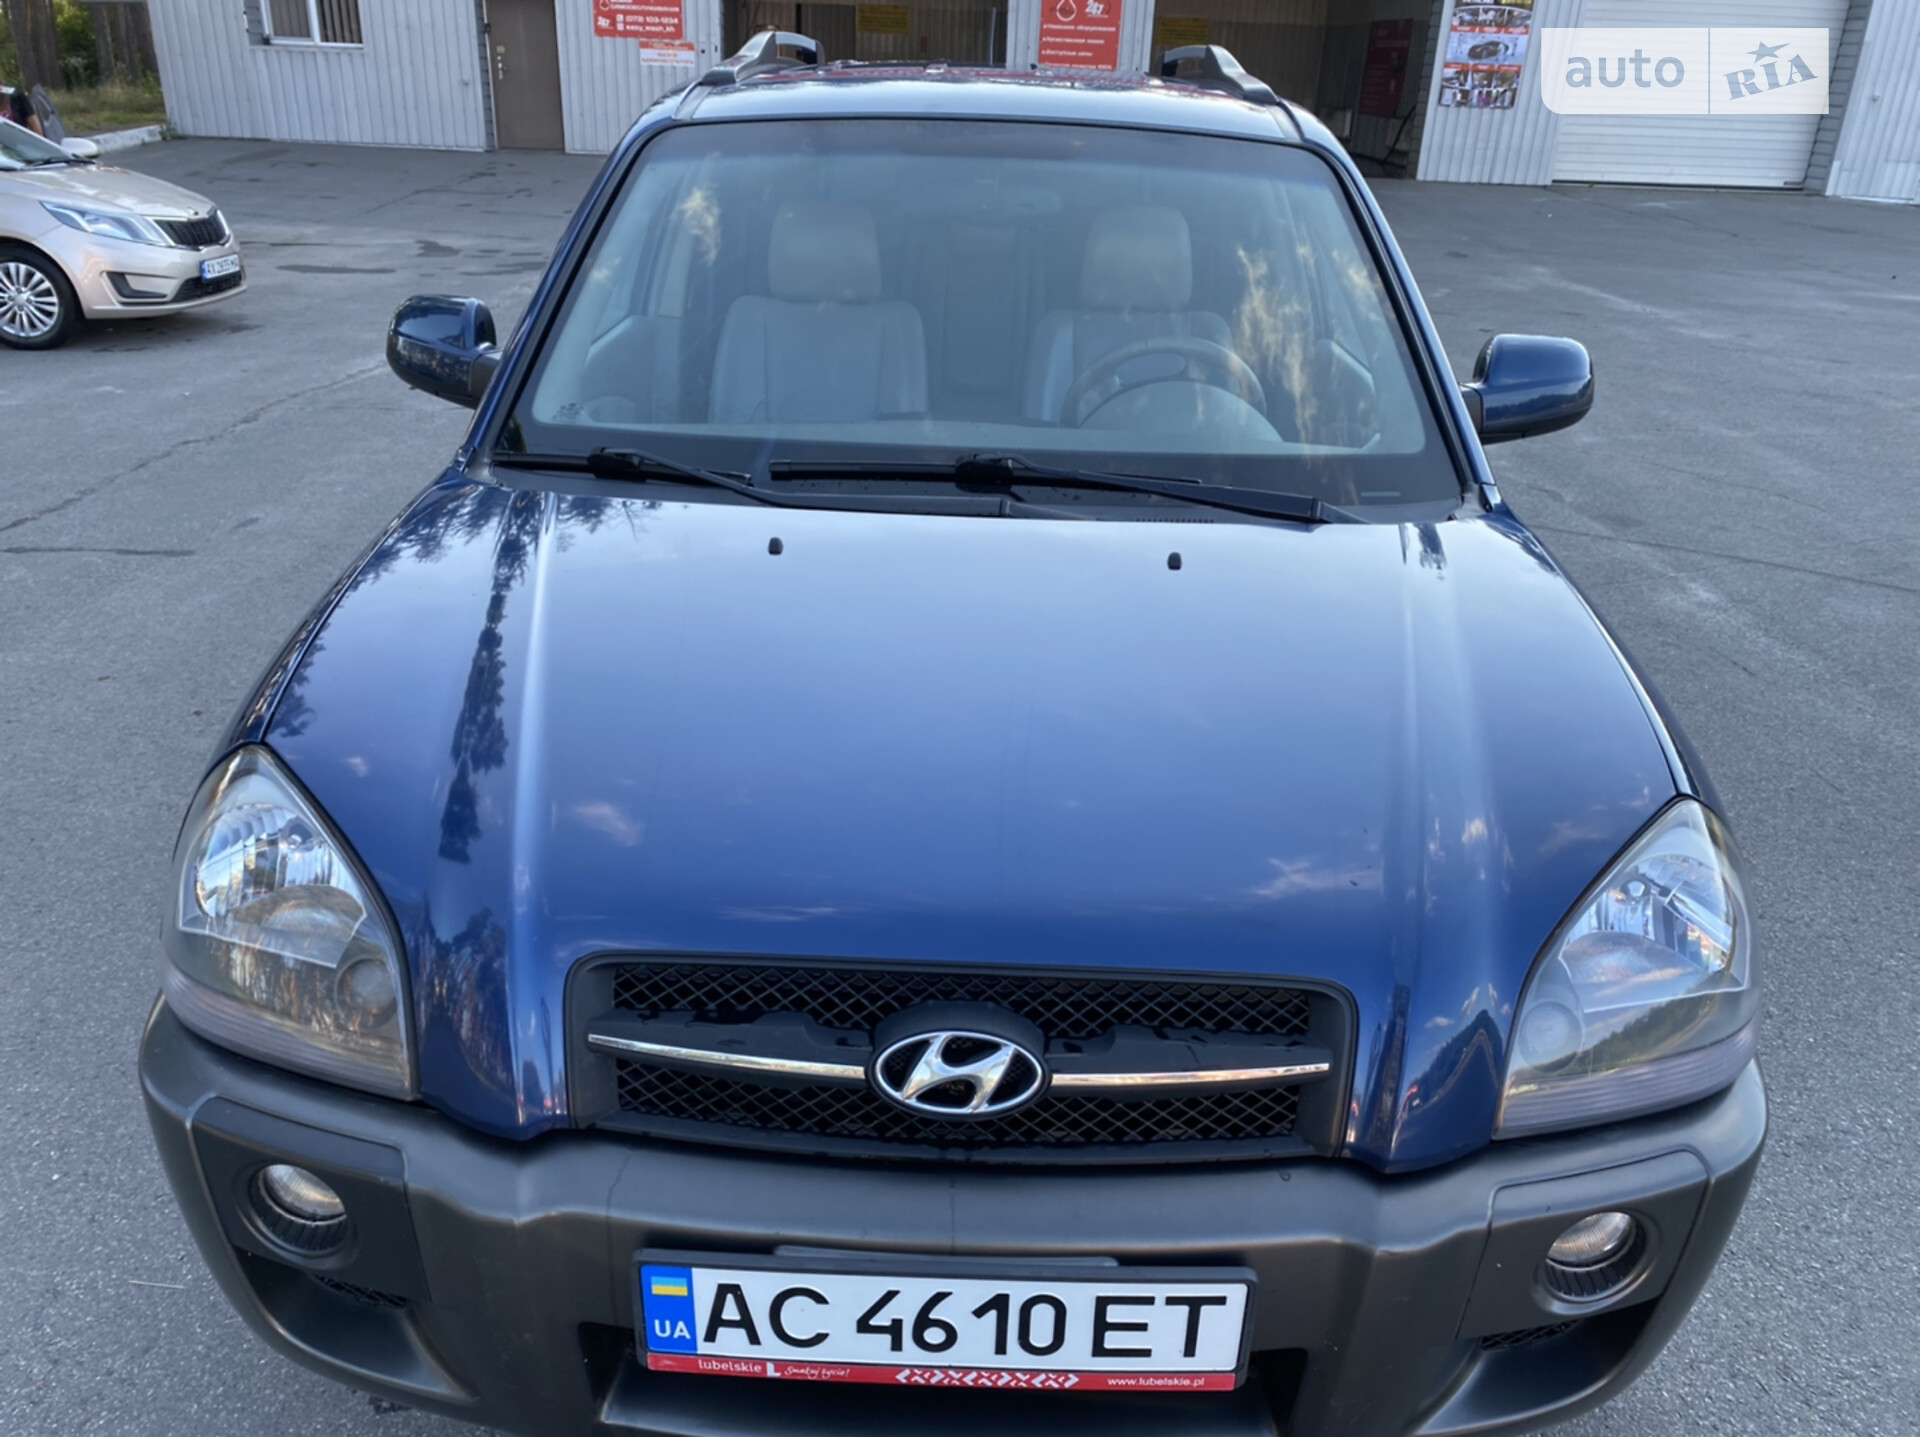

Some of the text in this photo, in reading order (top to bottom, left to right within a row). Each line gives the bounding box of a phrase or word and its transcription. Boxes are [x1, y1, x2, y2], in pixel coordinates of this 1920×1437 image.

[703, 1283, 1227, 1358] AC 4610 ET
[654, 1319, 690, 1339] UA
[698, 1360, 762, 1373] lubelskie
[1107, 1377, 1205, 1388] www.lubelskie.pl
